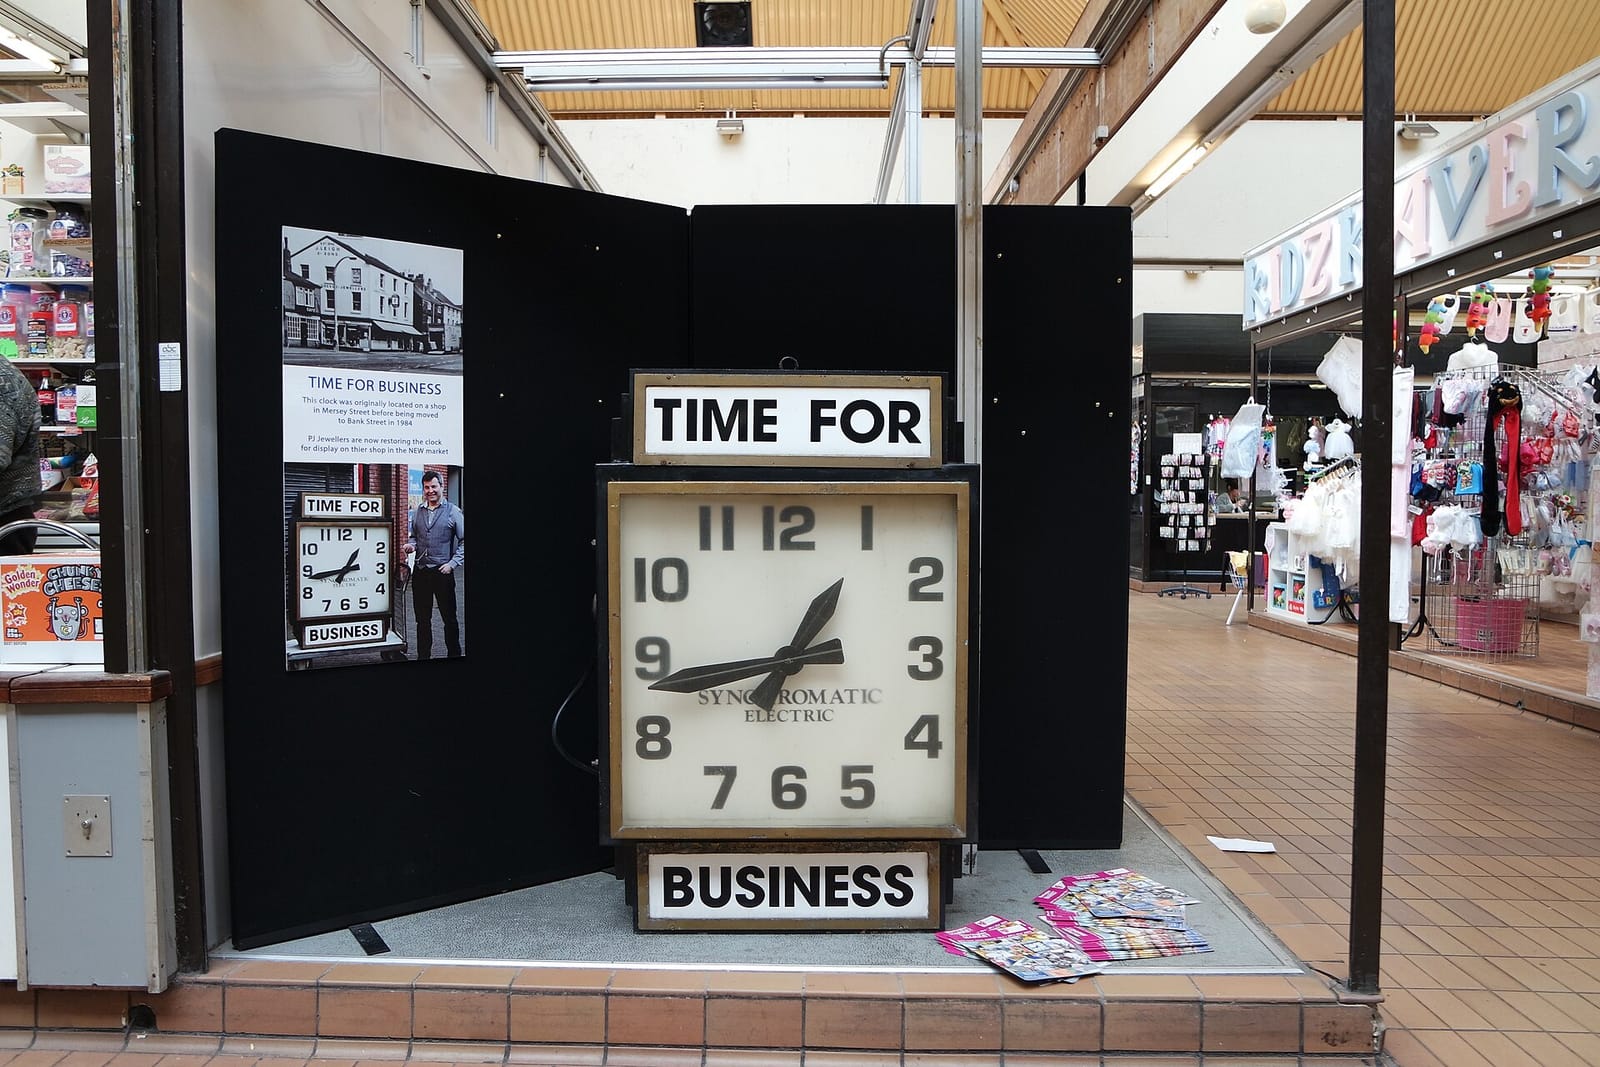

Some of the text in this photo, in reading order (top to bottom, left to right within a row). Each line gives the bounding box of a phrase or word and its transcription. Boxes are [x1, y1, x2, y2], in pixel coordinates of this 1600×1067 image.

[308, 376, 442, 395] TIME FOR BUSINESS
[319, 397, 338, 405] clock
[354, 400, 386, 408] originally
[388, 400, 413, 408] located
[430, 402, 447, 411] shop
[322, 407, 347, 416] Mersey
[395, 410, 415, 419] being
[653, 398, 922, 444] TIME FOR
[313, 445, 338, 454] display
[307, 499, 380, 513] TIME FOR
[320, 528, 330, 541] 11
[338, 528, 352, 541] 12
[364, 528, 368, 541] 1
[698, 505, 734, 550] 11
[762, 505, 816, 550] 12
[860, 505, 873, 550] 1
[302, 544, 318, 556] 10
[376, 542, 386, 554] 2
[303, 565, 313, 578] 9
[376, 563, 386, 574] 3
[5, 570, 36, 584] Golden
[634, 557, 689, 603] 10
[908, 556, 944, 602] 2
[6, 579, 39, 594] Wonder
[303, 587, 313, 600] 8
[375, 583, 386, 594] 4
[322, 600, 331, 612] 7
[340, 599, 350, 610] 6
[358, 597, 368, 609] 5
[309, 624, 378, 642] BUSINESS
[634, 636, 671, 682] 9
[907, 636, 944, 681] 3
[744, 708, 834, 722] ELECTRIC
[635, 715, 672, 760] 8
[904, 714, 944, 759] 4
[703, 765, 737, 810] 7
[770, 766, 808, 810] 6
[840, 764, 876, 809] 5
[662, 864, 914, 909] BUSINESS
